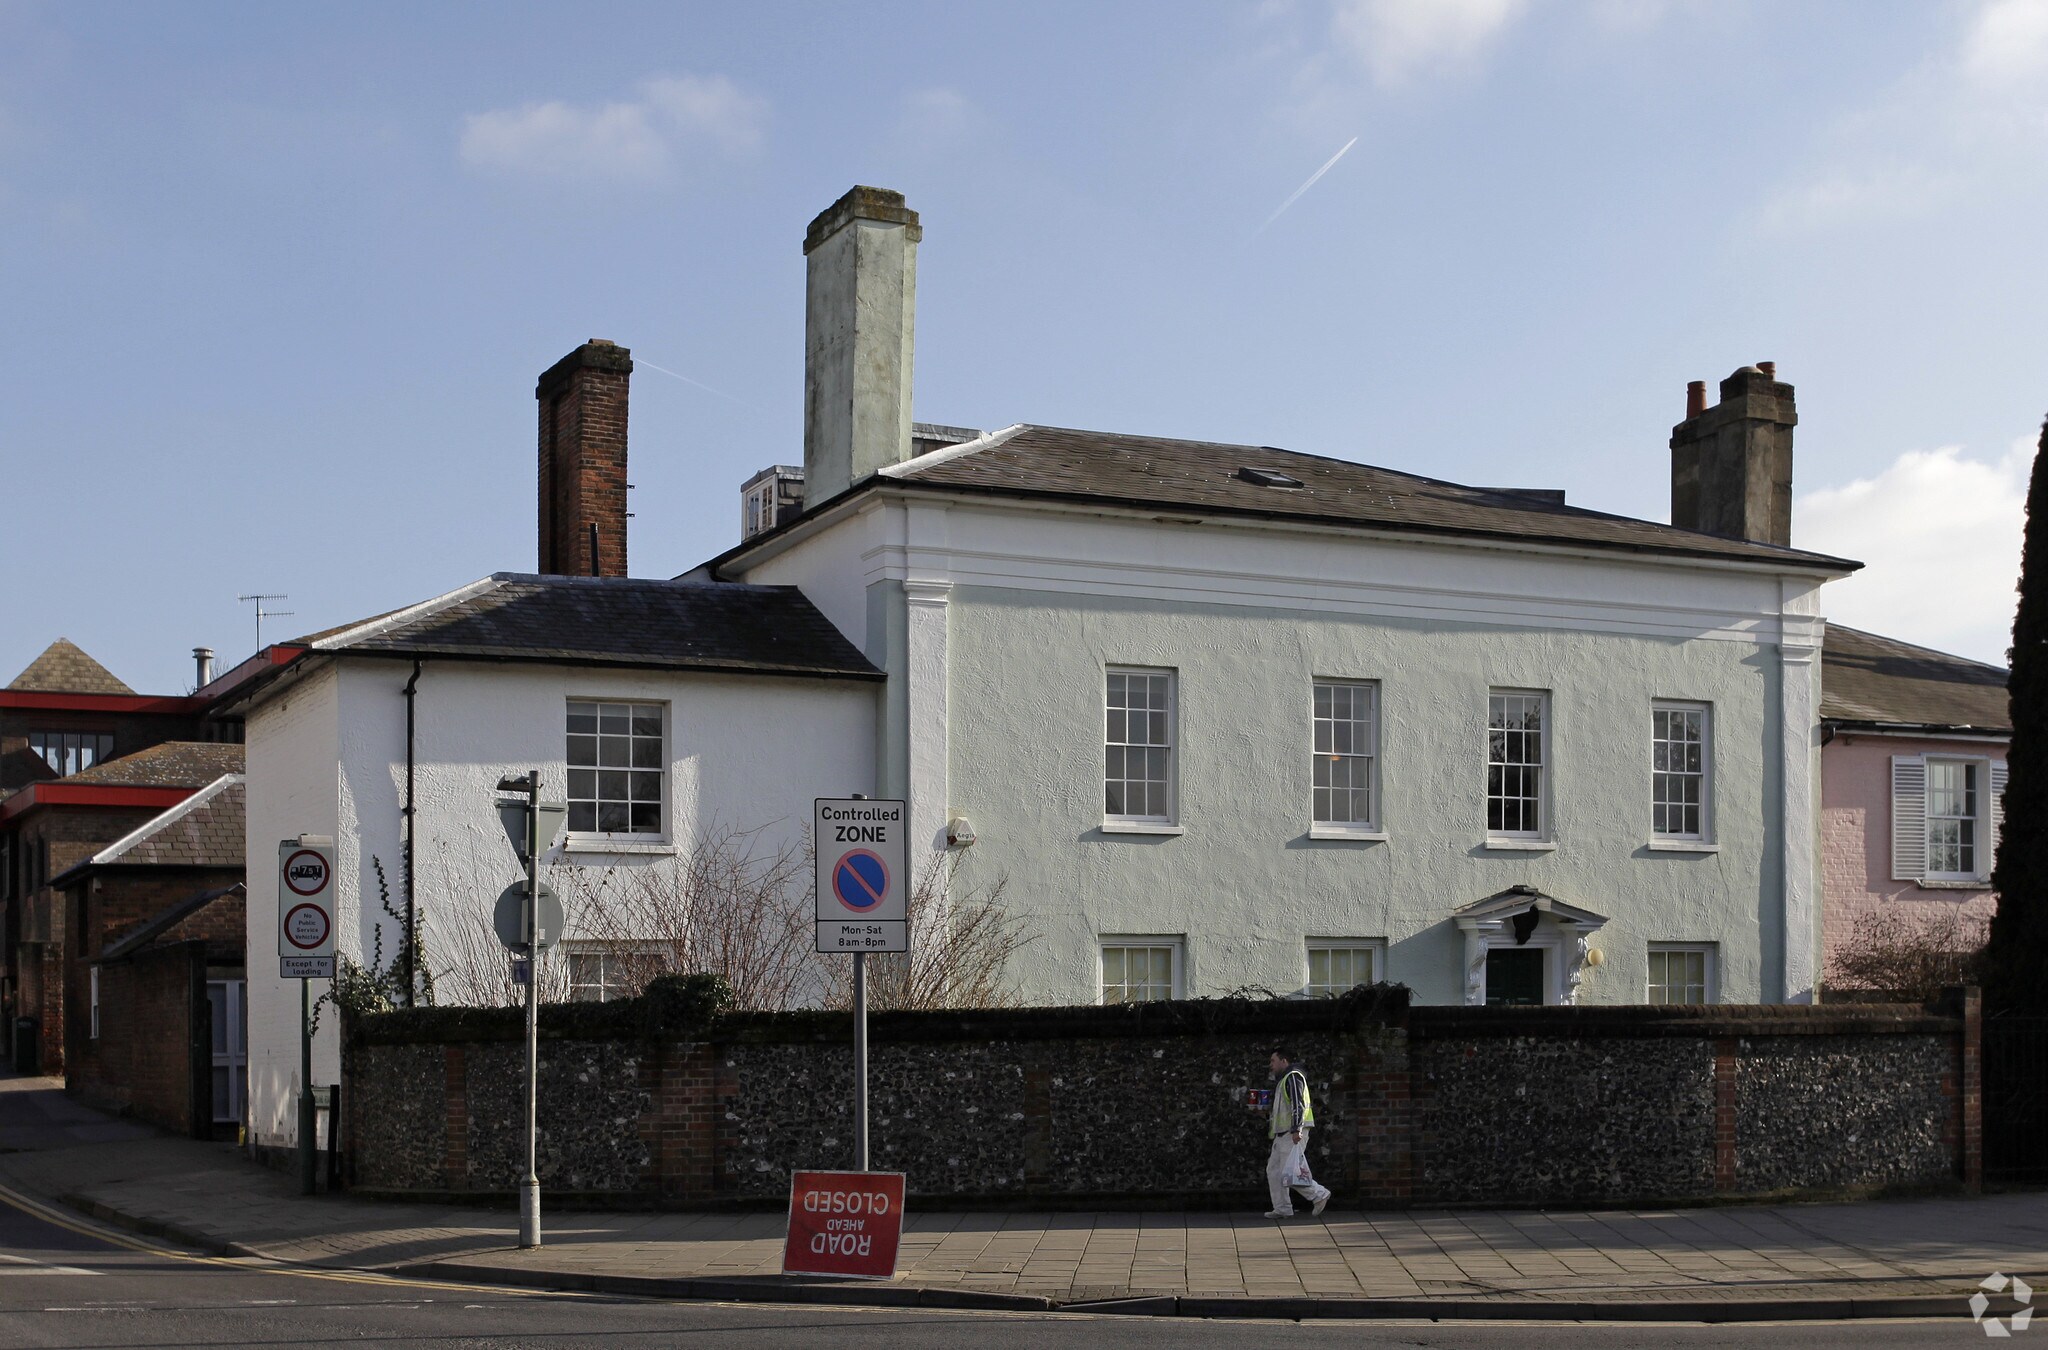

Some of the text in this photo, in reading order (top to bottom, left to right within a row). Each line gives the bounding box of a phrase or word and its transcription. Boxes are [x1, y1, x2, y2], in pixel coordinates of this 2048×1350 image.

[822, 806, 899, 821] Controlled
[835, 826, 886, 843] ZONE
[841, 925, 882, 935] Mon-Sat
[286, 960, 312, 968] Except
[803, 1190, 890, 1215] CLOSED
[826, 1219, 865, 1231] AHEAD
[810, 1232, 872, 1257] ROAD
